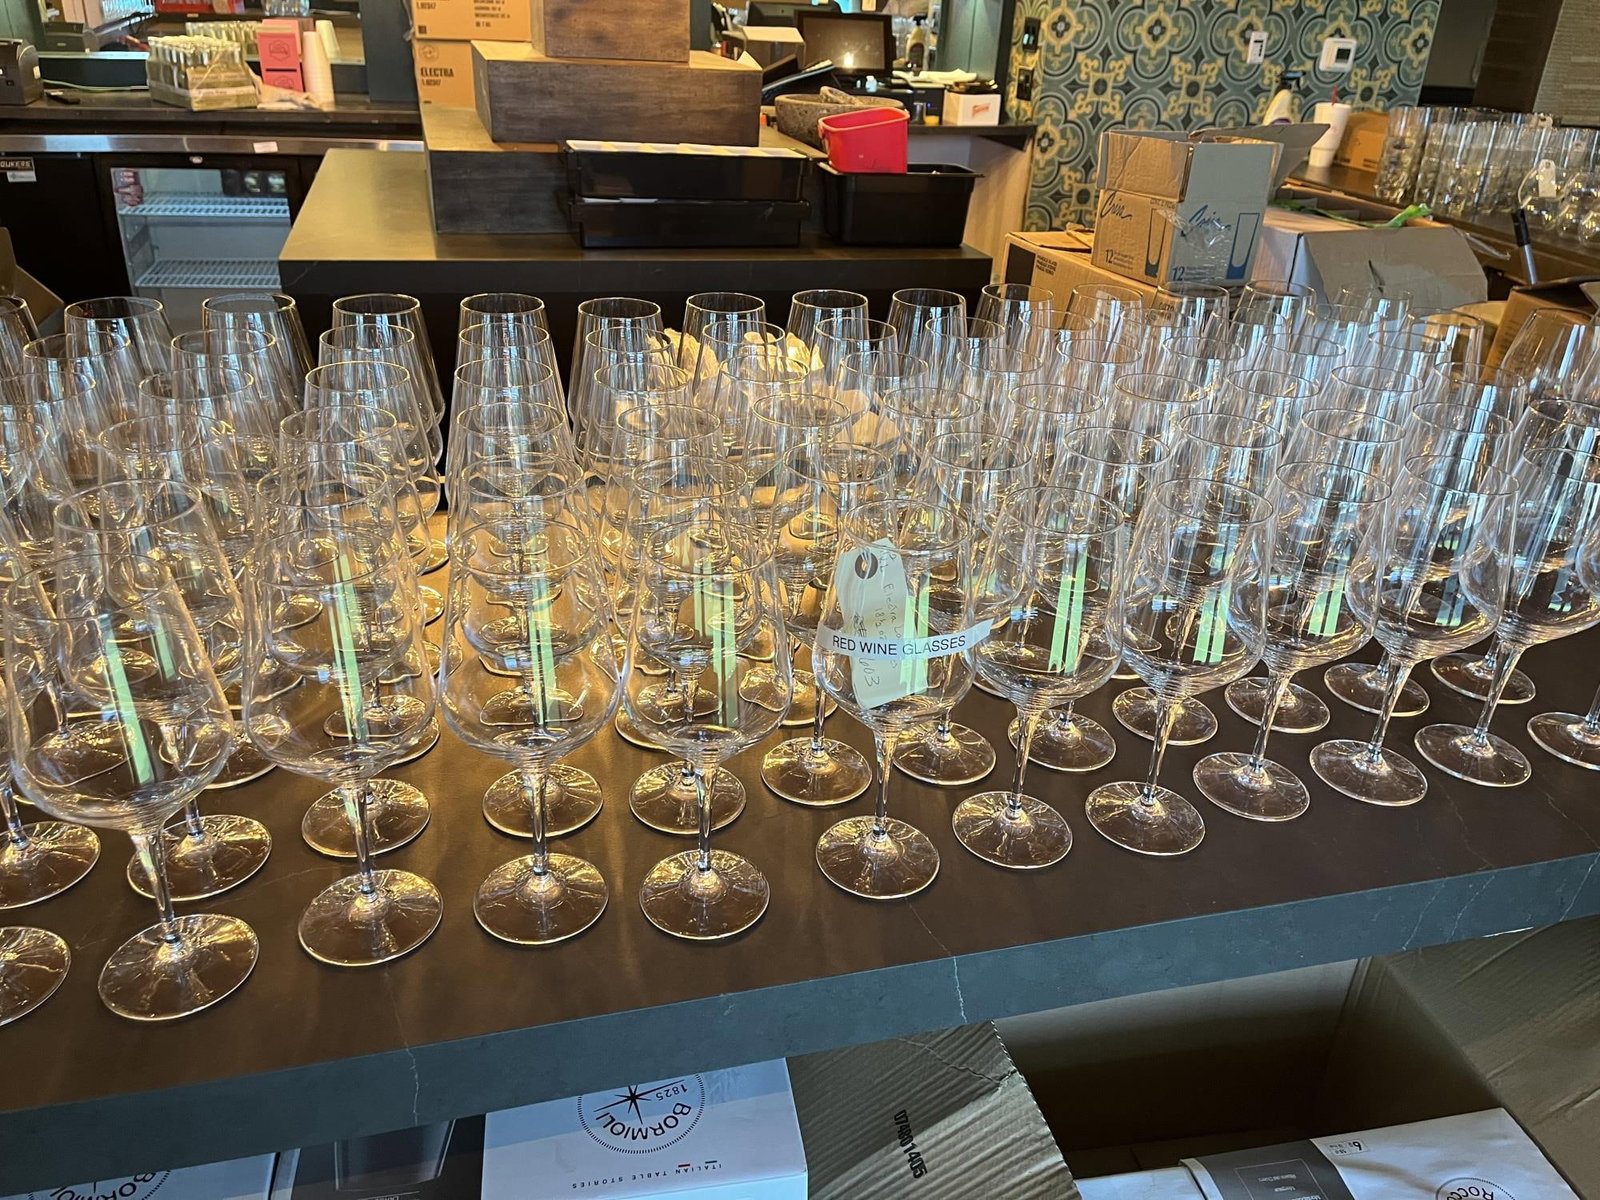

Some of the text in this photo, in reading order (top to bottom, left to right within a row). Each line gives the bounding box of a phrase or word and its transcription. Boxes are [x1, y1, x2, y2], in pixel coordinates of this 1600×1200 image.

[832, 635, 966, 656] RED WINE GLASSES
[655, 1084, 688, 1102] 1825
[595, 1102, 692, 1141] BORMIOLI
[572, 1164, 722, 1189] ITALIAN TABLE STORIES
